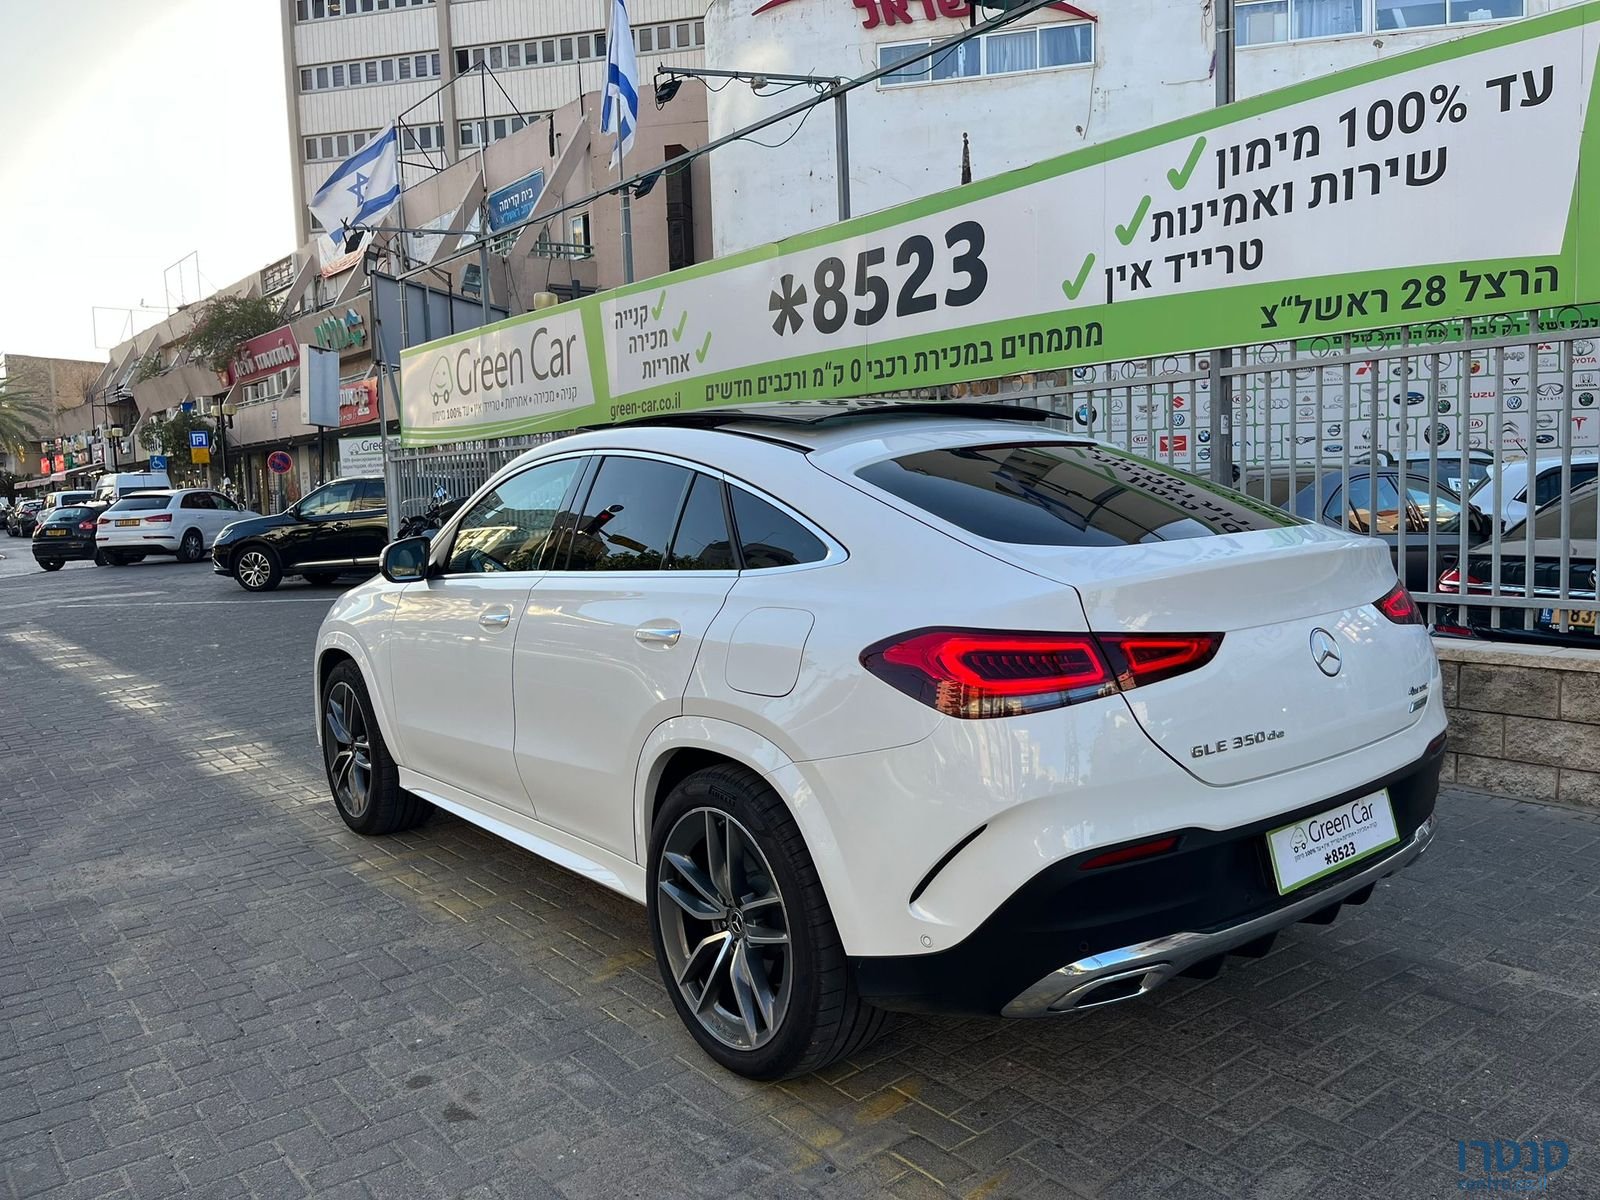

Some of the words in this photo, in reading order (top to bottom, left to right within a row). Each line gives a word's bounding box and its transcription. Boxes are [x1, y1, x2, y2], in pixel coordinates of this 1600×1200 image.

[1487, 66, 1553, 112] עד
[1340, 85, 1466, 147] 100%
[1217, 126, 1319, 189] מימון
[1309, 147, 1446, 208] שירות
[499, 196, 520, 213] קדימה
[1151, 182, 1293, 242] ואמינות
[1165, 239, 1262, 283] טרייד
[1106, 260, 1153, 304] אין
[1402, 276, 1447, 309] 28
[1460, 266, 1559, 303] הרצל
[616, 306, 648, 330] קנייה
[1454, 325, 1497, 337] לבחר
[1502, 324, 1521, 336] רק
[1526, 321, 1566, 331] נשא
[630, 329, 668, 353] מכירה
[1002, 322, 1103, 360] מתמחים
[1333, 332, 1373, 344] שלם
[457, 347, 524, 396] Green
[531, 327, 577, 381] Car
[643, 354, 690, 380] אחריות
[851, 359, 862, 383] 0
[867, 356, 908, 380] רכבי
[914, 341, 994, 374] במכירת
[706, 379, 753, 402] חדשים
[758, 371, 807, 395] ורכבים
[610, 392, 681, 420] green-car.co.il
[361, 440, 383, 452] Gree
[1190, 740, 1228, 759] GLE
[1309, 814, 1351, 843] Green
[1352, 802, 1374, 825] Car
